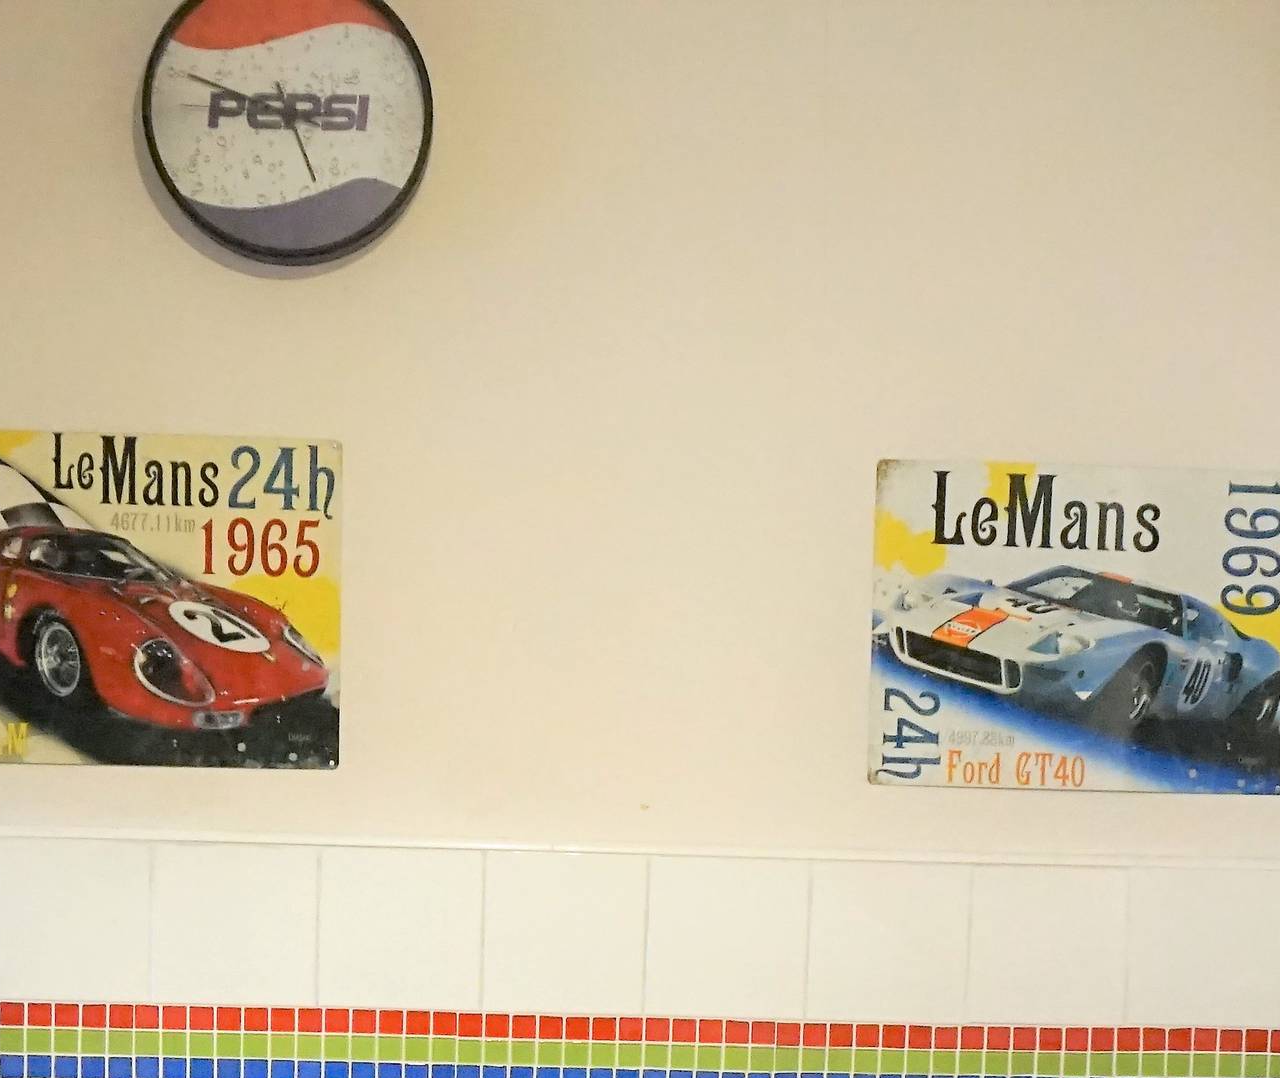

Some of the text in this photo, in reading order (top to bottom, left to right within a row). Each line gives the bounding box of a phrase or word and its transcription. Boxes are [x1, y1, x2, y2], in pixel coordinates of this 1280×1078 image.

[228, 444, 336, 519] 24h
[201, 517, 320, 578] 1965
[876, 687, 941, 780] 24h
[947, 749, 1086, 788] Ford GT40
